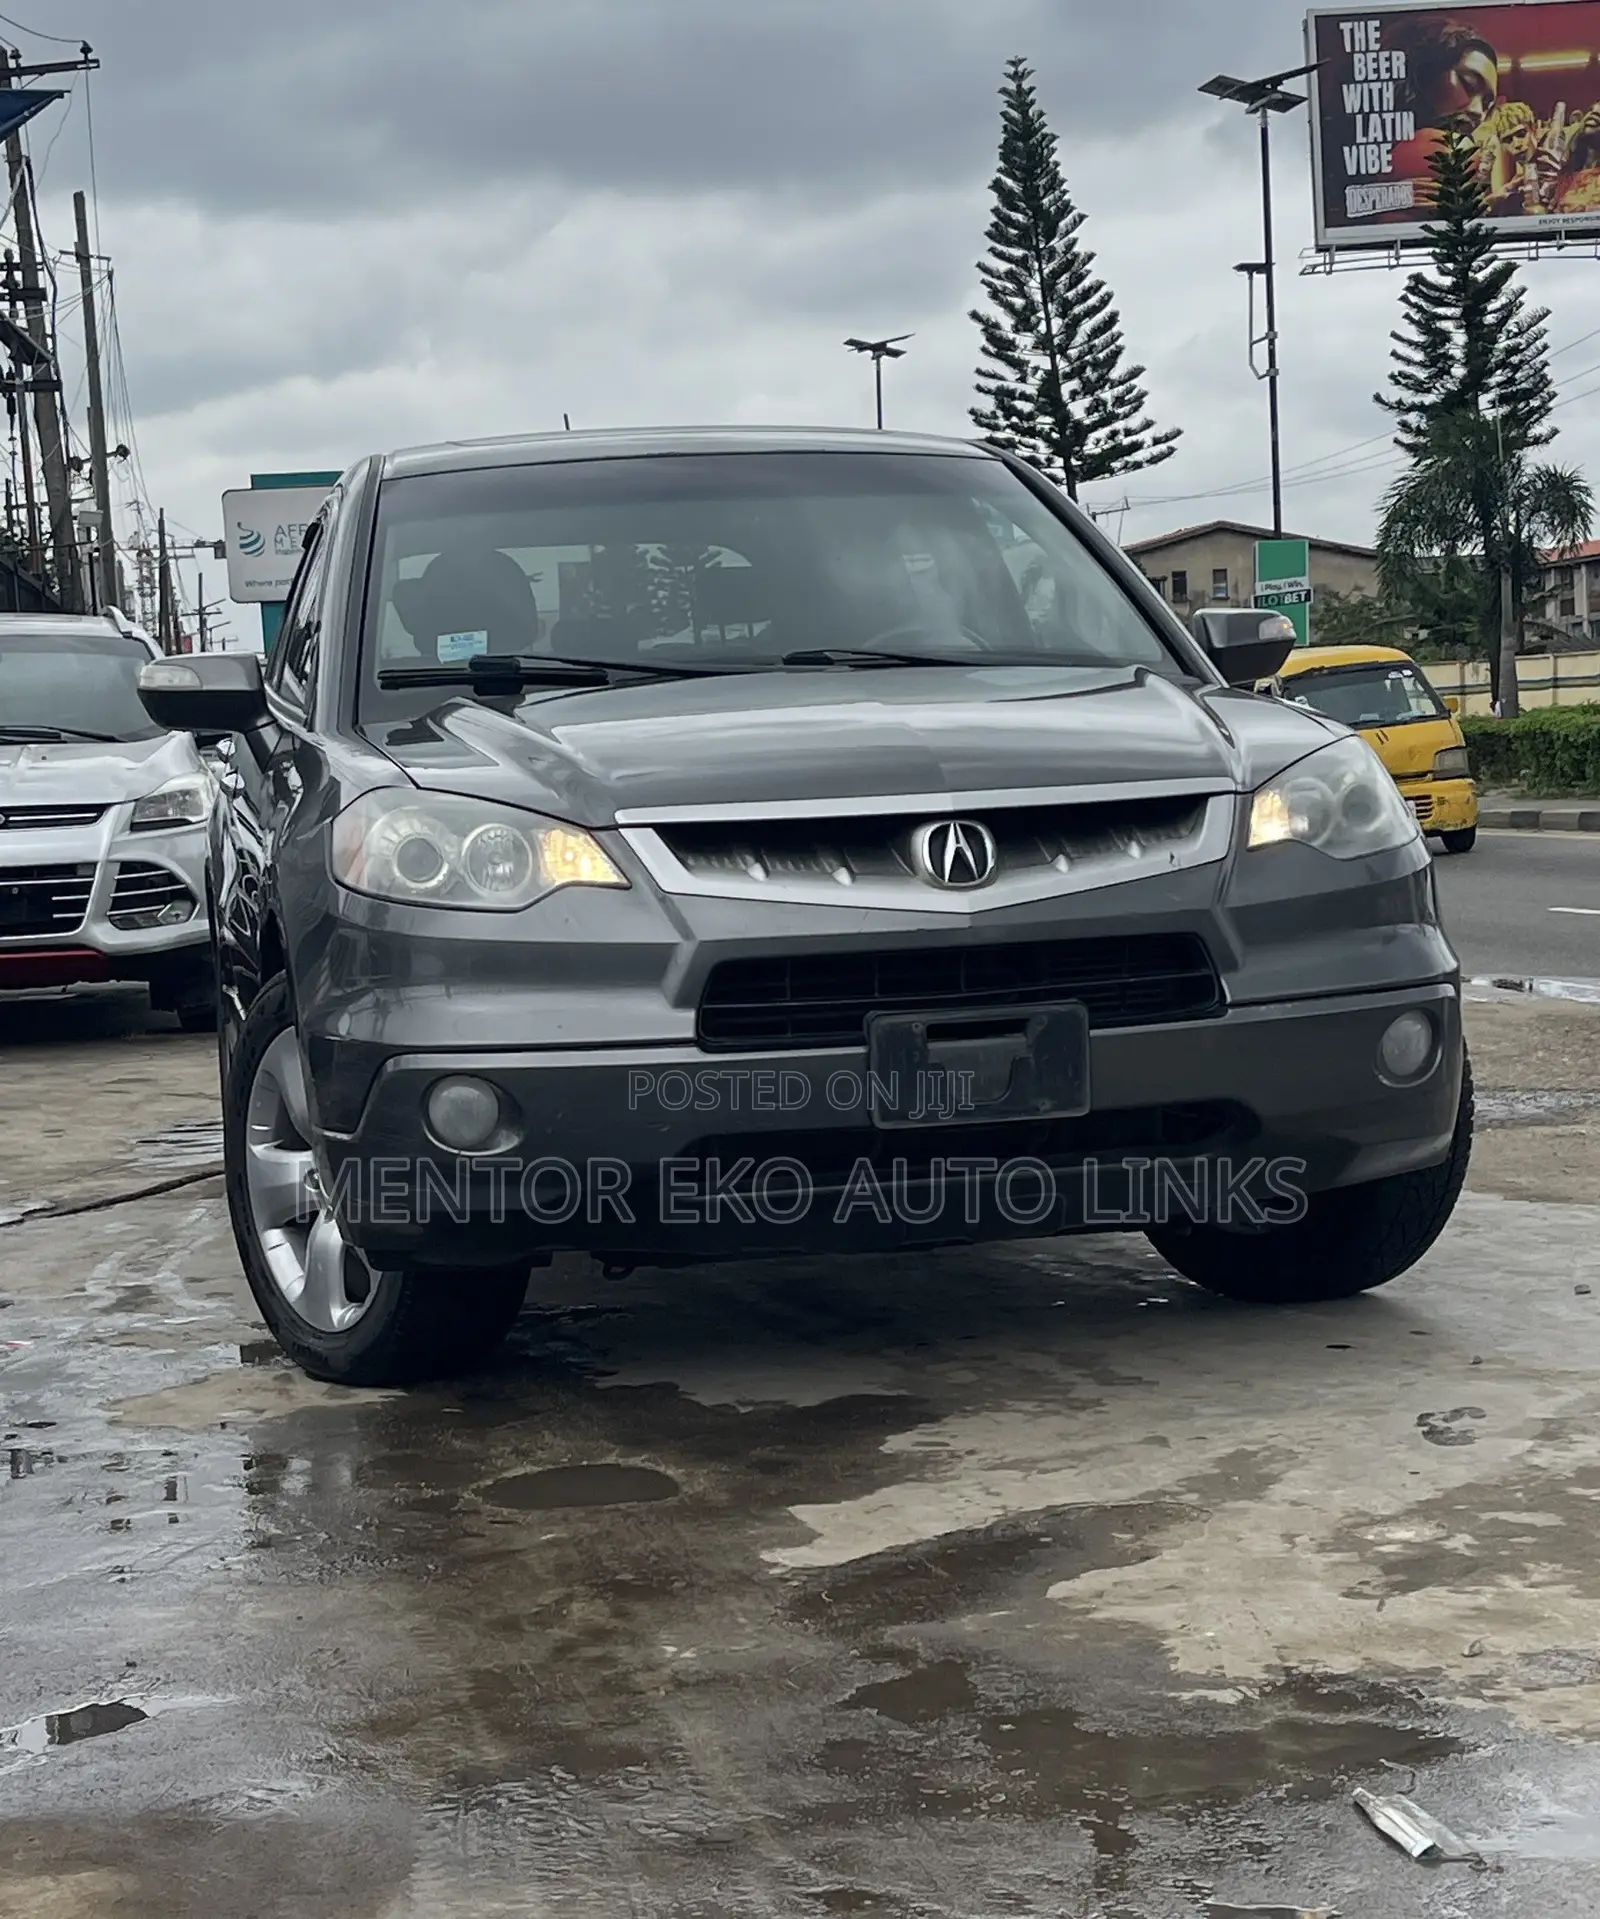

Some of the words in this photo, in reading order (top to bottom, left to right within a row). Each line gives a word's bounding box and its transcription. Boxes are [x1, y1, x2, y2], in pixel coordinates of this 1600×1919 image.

[1339, 20, 1381, 53] THE
[1353, 51, 1407, 82] BEER
[1342, 82, 1396, 114] WITH
[1356, 111, 1416, 144] LATIN
[1342, 143, 1393, 176] VIBE
